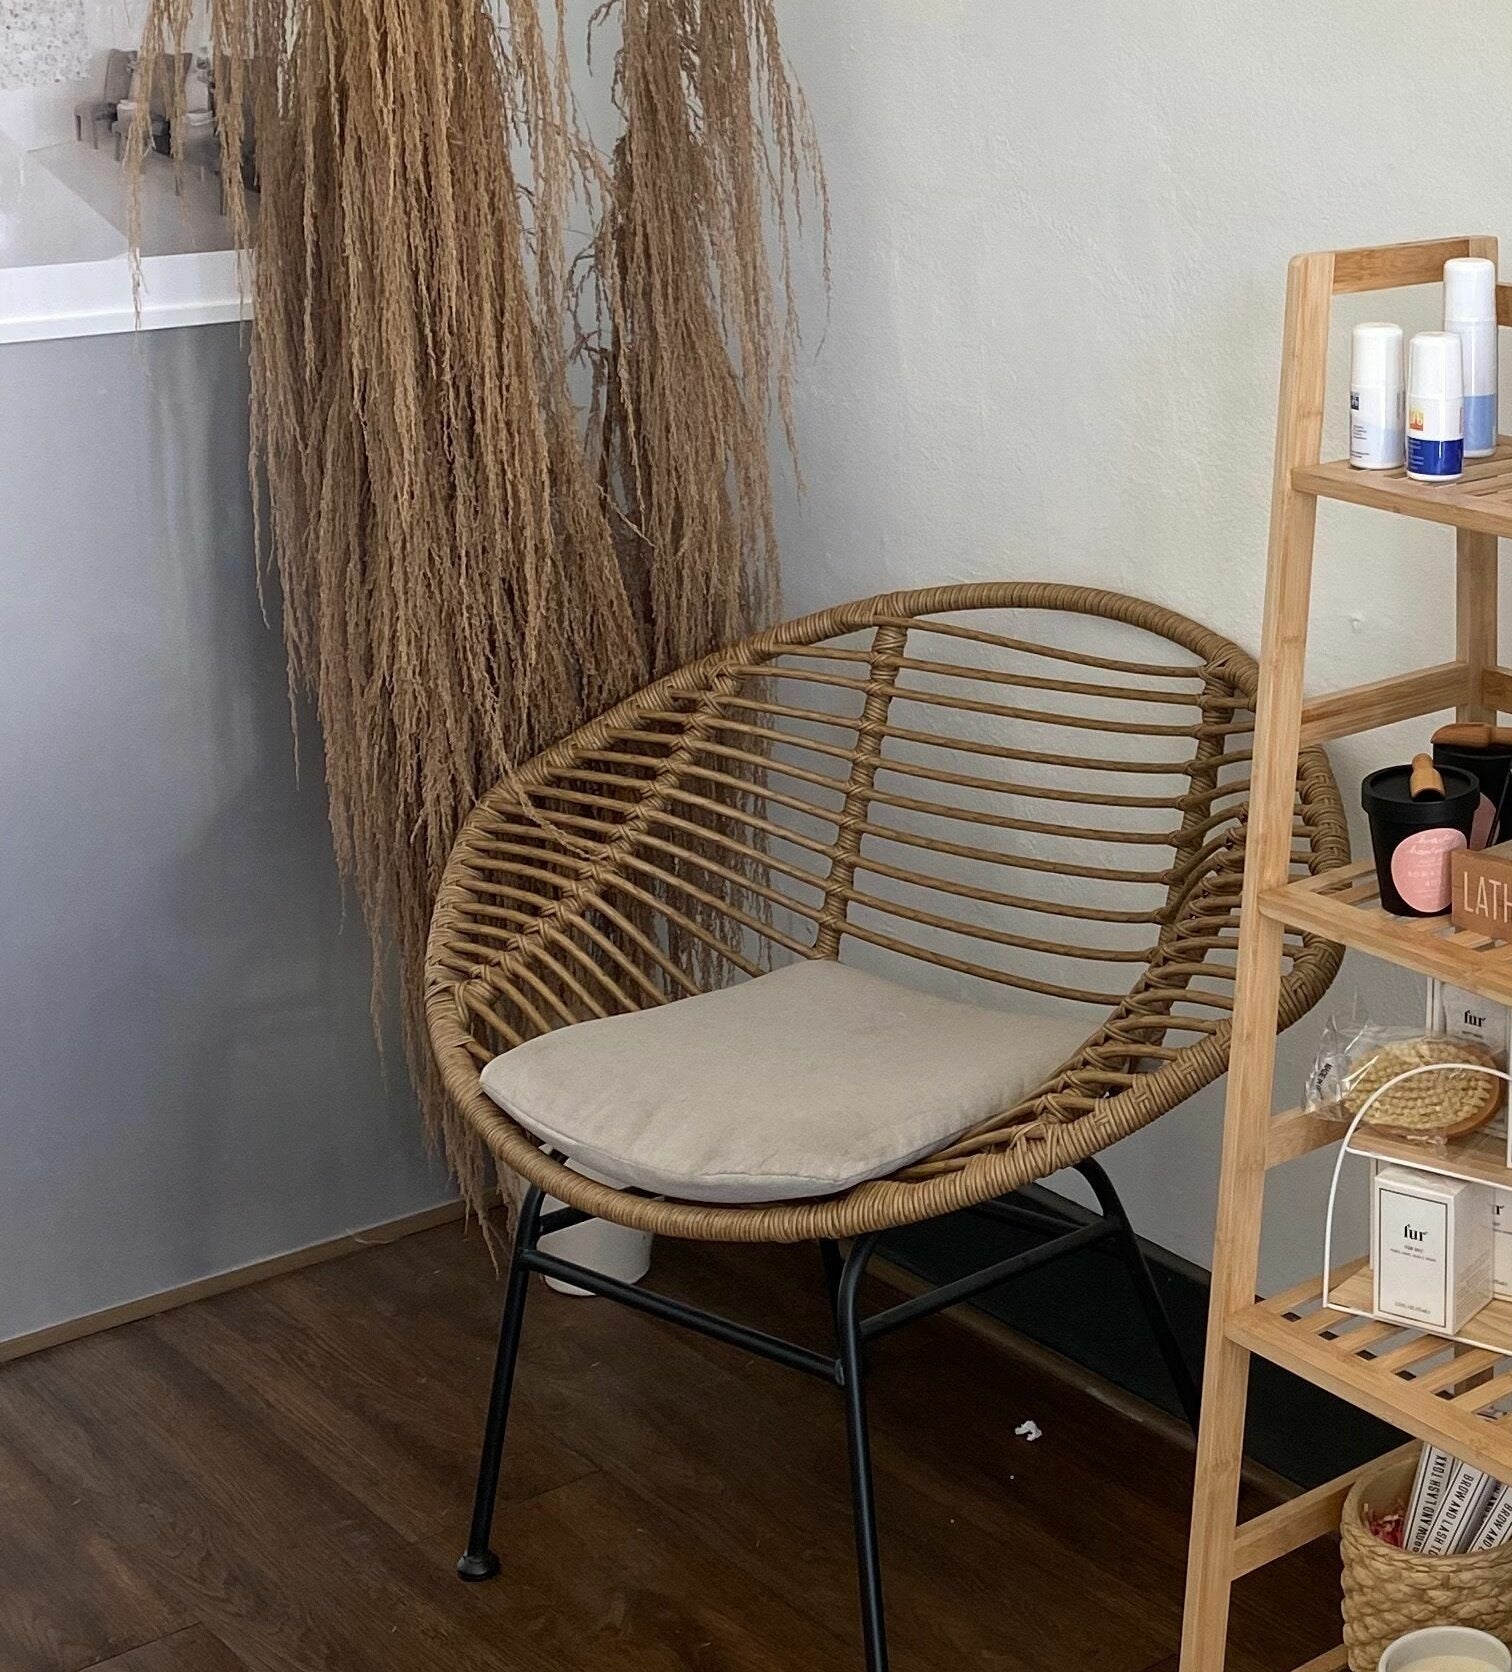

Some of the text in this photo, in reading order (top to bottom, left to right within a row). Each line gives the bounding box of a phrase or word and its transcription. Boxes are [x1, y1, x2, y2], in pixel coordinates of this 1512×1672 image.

[1464, 1009, 1487, 1028] fur
[1404, 1224, 1429, 1242] fur
[1431, 1454, 1448, 1479] TOXX
[1424, 1480, 1441, 1506] LASH
[1454, 1473, 1475, 1502] BROW
[1420, 1506, 1436, 1526] AND
[1445, 1500, 1461, 1520] AND
[1435, 1519, 1454, 1545] LASH
[1482, 1528, 1498, 1548] AND
